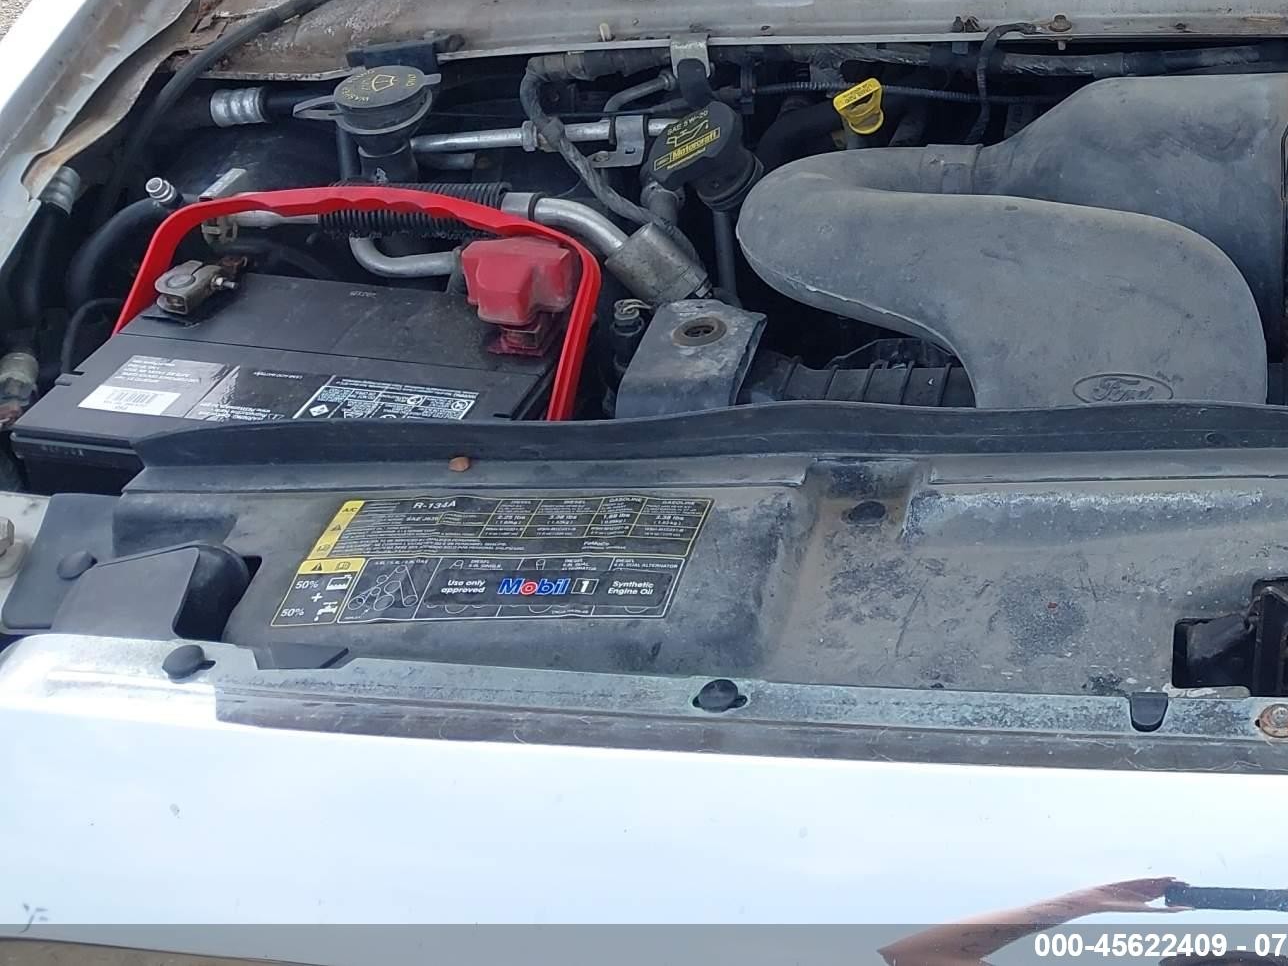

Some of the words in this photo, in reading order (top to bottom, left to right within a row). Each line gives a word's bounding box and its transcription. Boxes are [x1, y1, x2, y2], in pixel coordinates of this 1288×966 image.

[672, 130, 716, 161] Motorcraft
[413, 500, 456, 508] R-134A
[295, 580, 319, 589] 50%
[497, 578, 572, 595] Mobil
[280, 608, 305, 616] 50%
